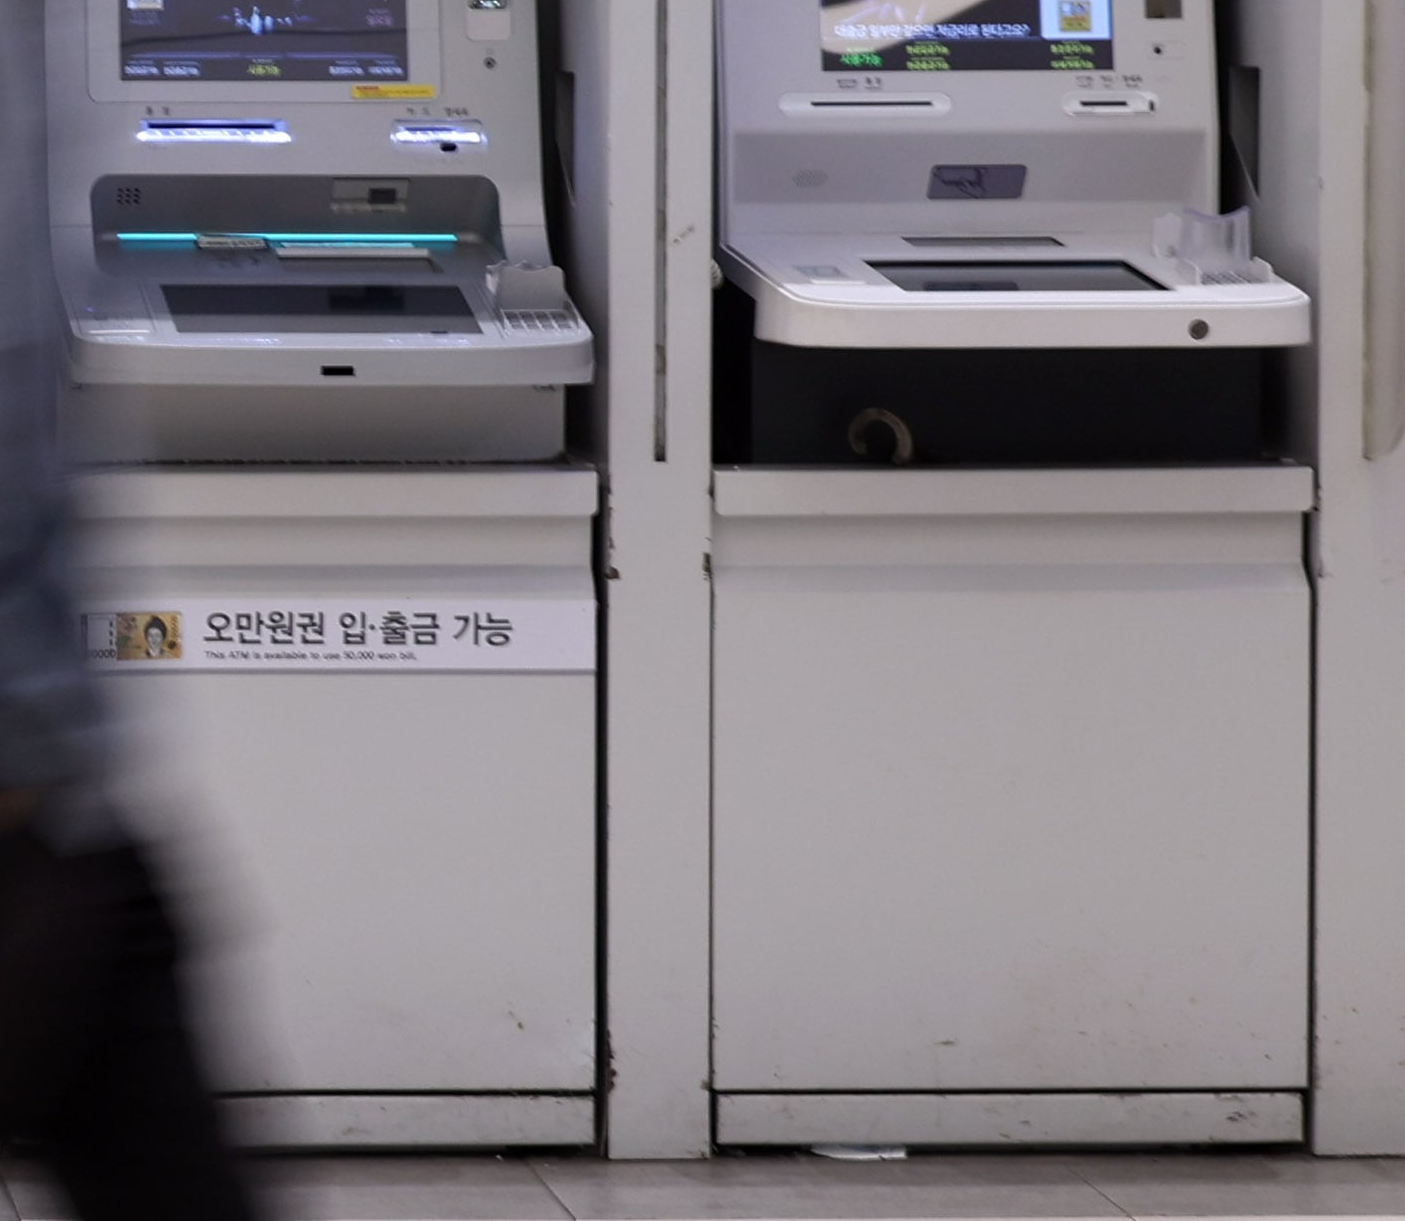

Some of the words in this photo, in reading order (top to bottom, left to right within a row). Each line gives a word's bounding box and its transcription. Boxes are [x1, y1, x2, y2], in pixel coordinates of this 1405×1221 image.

[203, 611, 325, 645] 오만원권
[338, 611, 440, 645] 입·출금
[453, 612, 513, 646] 가능
[205, 651, 225, 661] This
[264, 651, 307, 661] available
